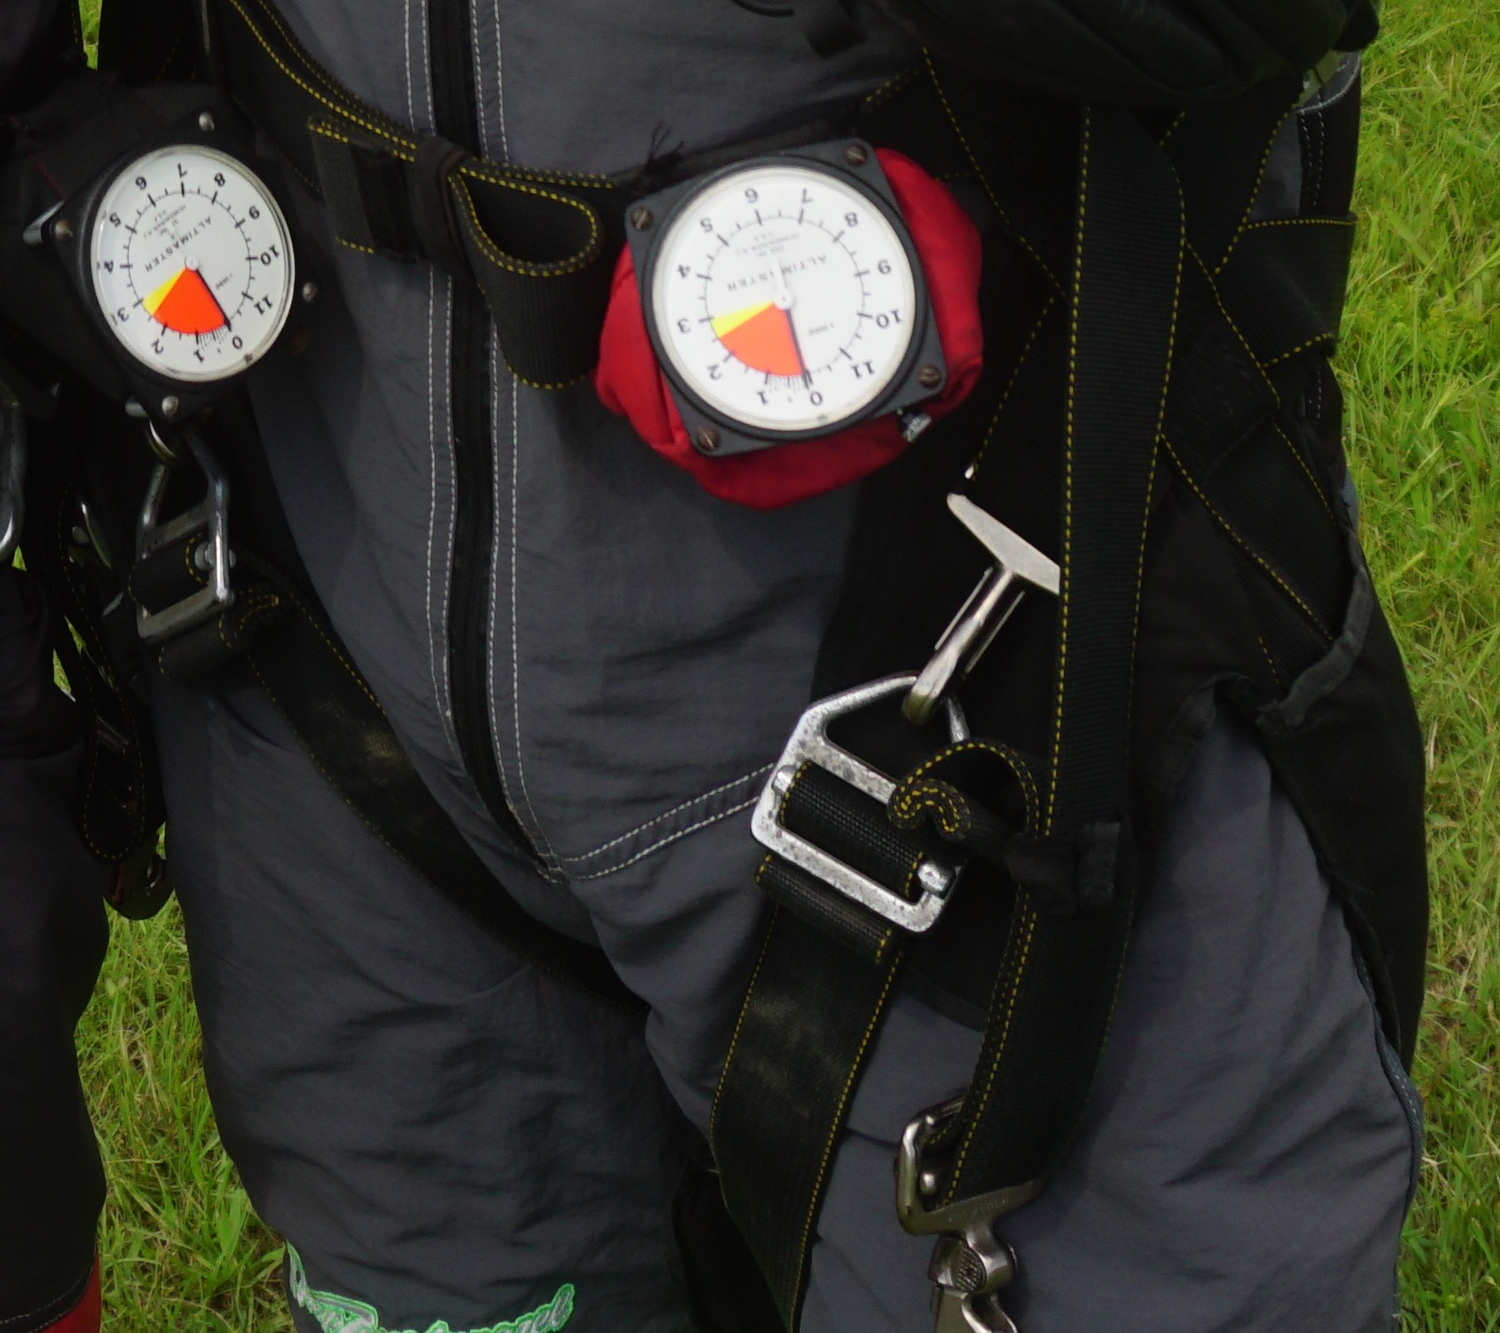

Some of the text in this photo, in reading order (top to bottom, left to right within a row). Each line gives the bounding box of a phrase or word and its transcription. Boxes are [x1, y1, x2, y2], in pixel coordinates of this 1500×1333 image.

[178, 163, 188, 178] 7
[135, 176, 147, 191] 6
[214, 172, 226, 187] 8
[744, 188, 759, 203] 6
[801, 188, 813, 204] 7
[249, 205, 260, 220] 9
[844, 211, 858, 228] 8
[109, 213, 121, 228] 5
[700, 217, 714, 233] 5
[145, 216, 212, 272] ALTIMASTER
[260, 244, 280, 266] 10
[103, 260, 114, 273] 4
[676, 264, 691, 279] 4
[877, 259, 892, 275] 9
[254, 295, 273, 316] 11
[117, 307, 130, 322] 3
[876, 308, 902, 329] 10
[676, 318, 691, 334] 3
[151, 339, 164, 354] 2
[232, 336, 243, 350] 0
[193, 350, 204, 363] 1
[707, 365, 722, 380] 2
[852, 361, 875, 379] 11
[757, 390, 770, 405] 1
[810, 391, 823, 406] 0
